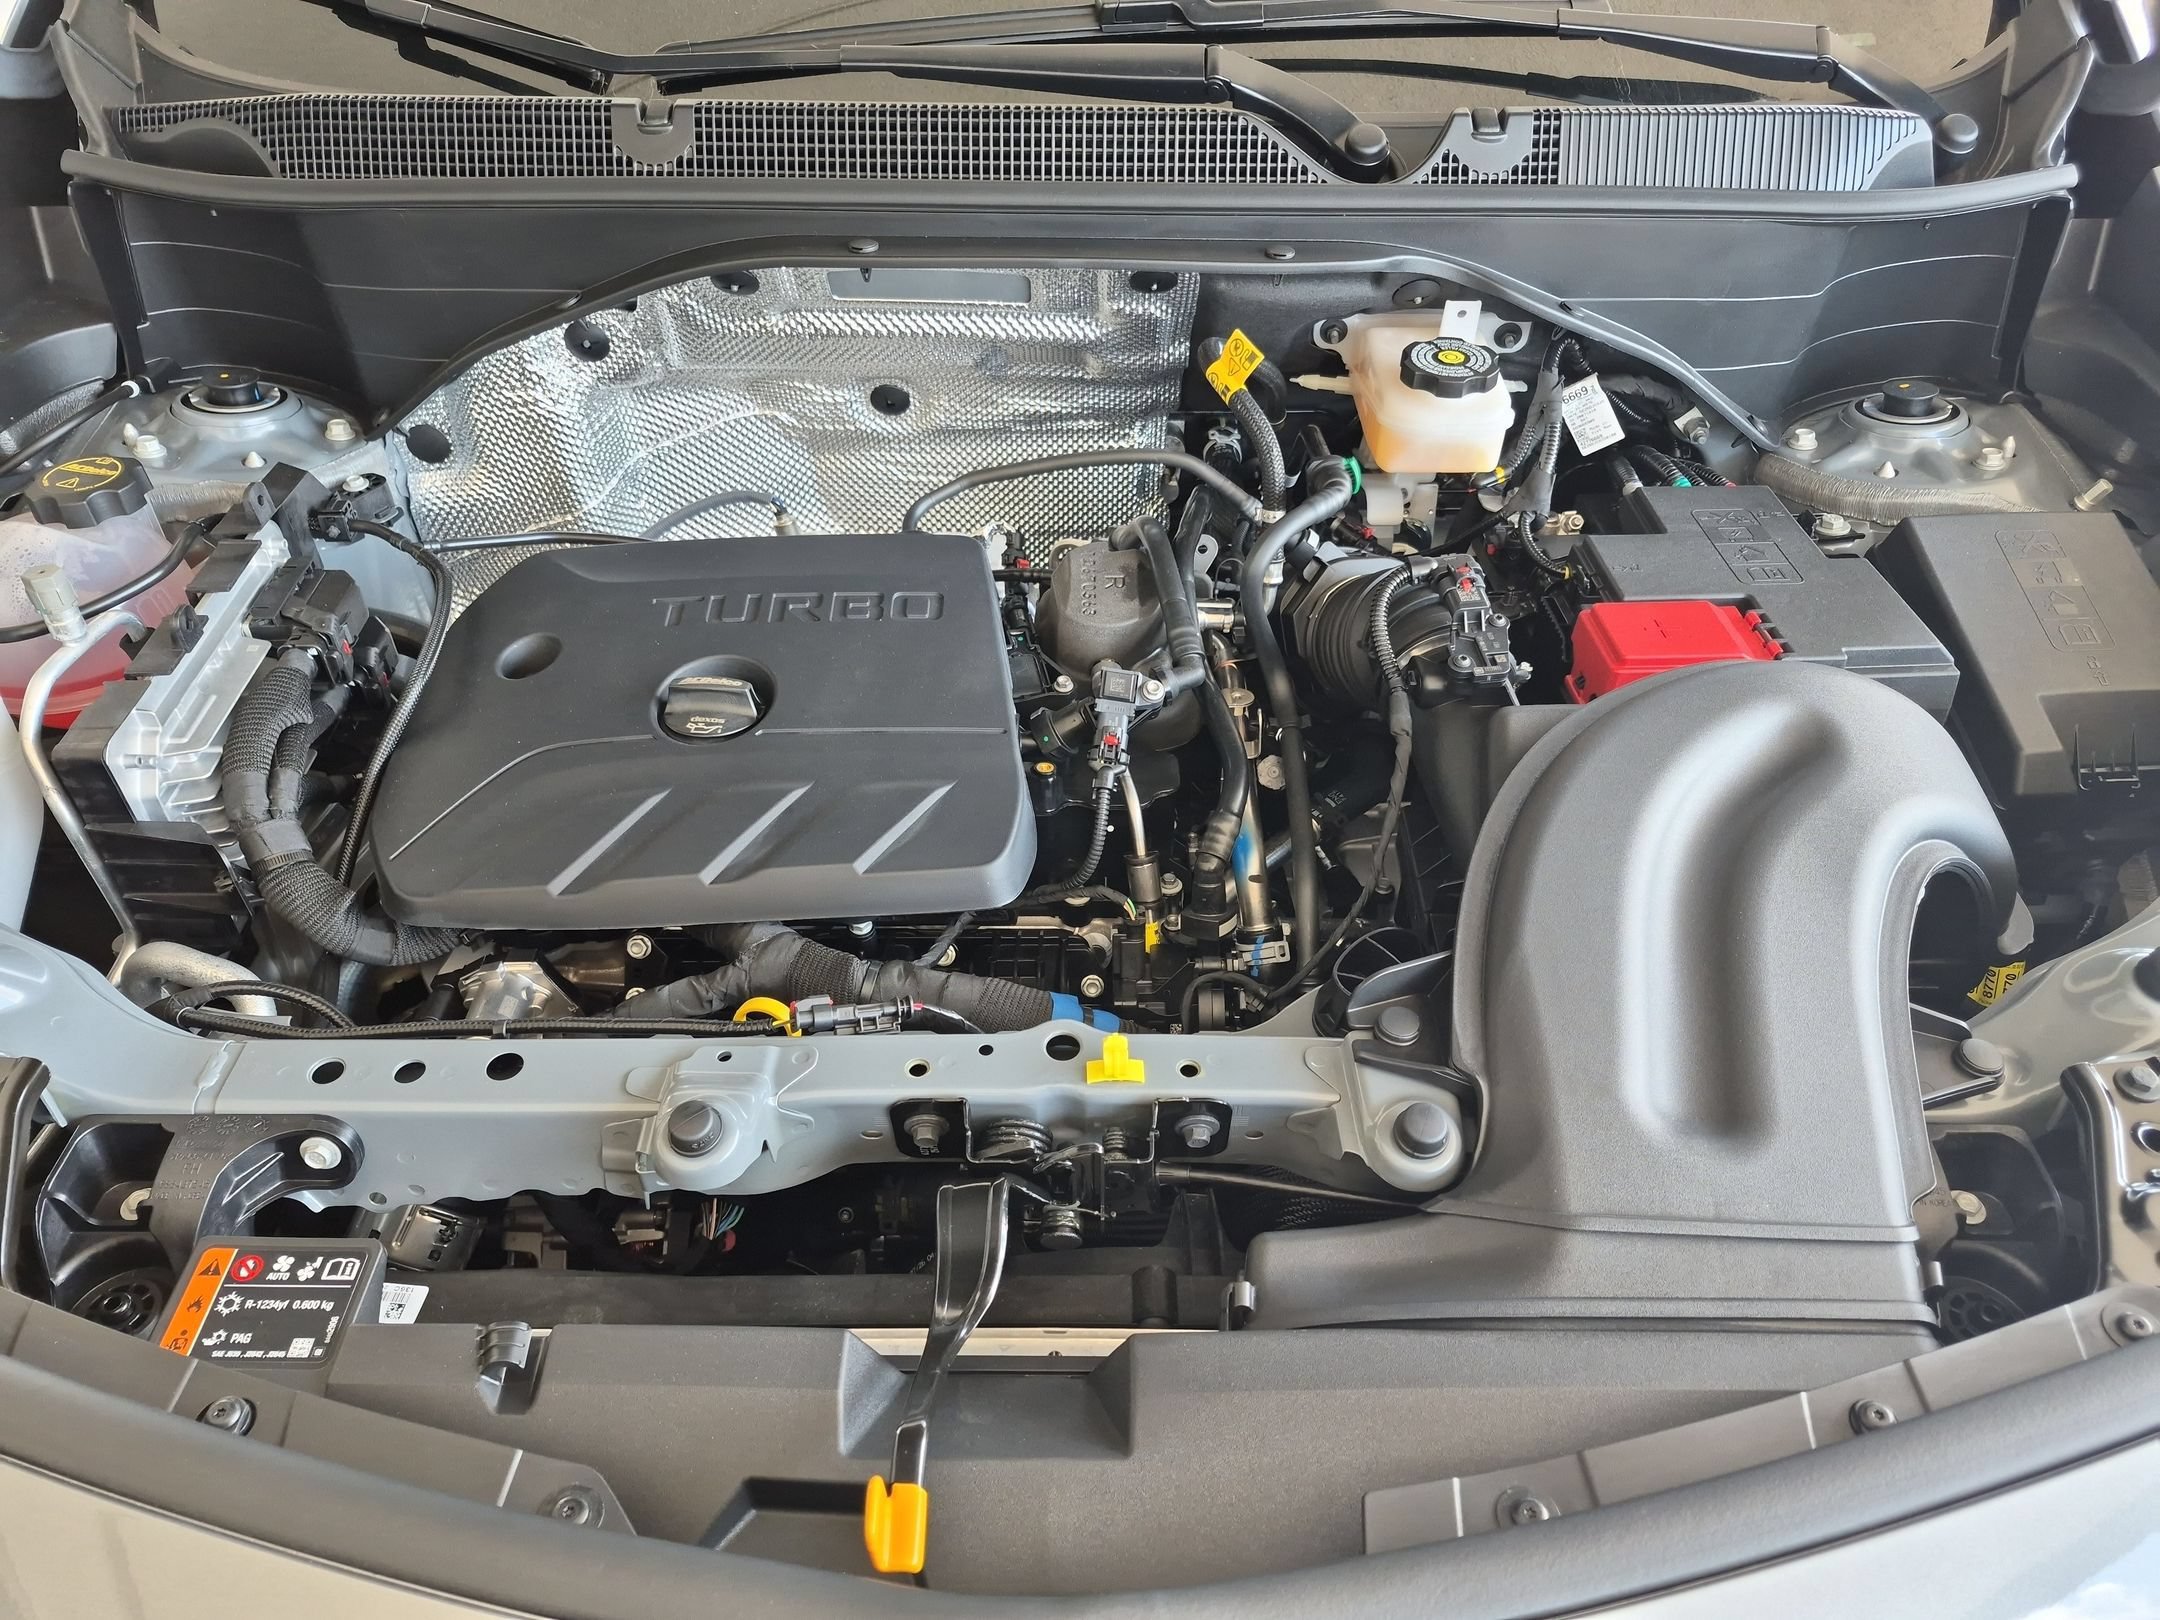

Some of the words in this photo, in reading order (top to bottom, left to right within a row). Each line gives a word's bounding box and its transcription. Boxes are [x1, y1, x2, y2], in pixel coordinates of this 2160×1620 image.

[1562, 385, 1589, 405] 6669
[1104, 574, 1126, 590] R
[652, 591, 945, 627] TURBO
[690, 716, 727, 724] dexos
[266, 1271, 292, 1281] AUTO
[244, 1299, 291, 1312] R-1234yf
[292, 1300, 319, 1310] 0.600
[320, 1300, 335, 1312] kg
[229, 1332, 253, 1344] PAG
